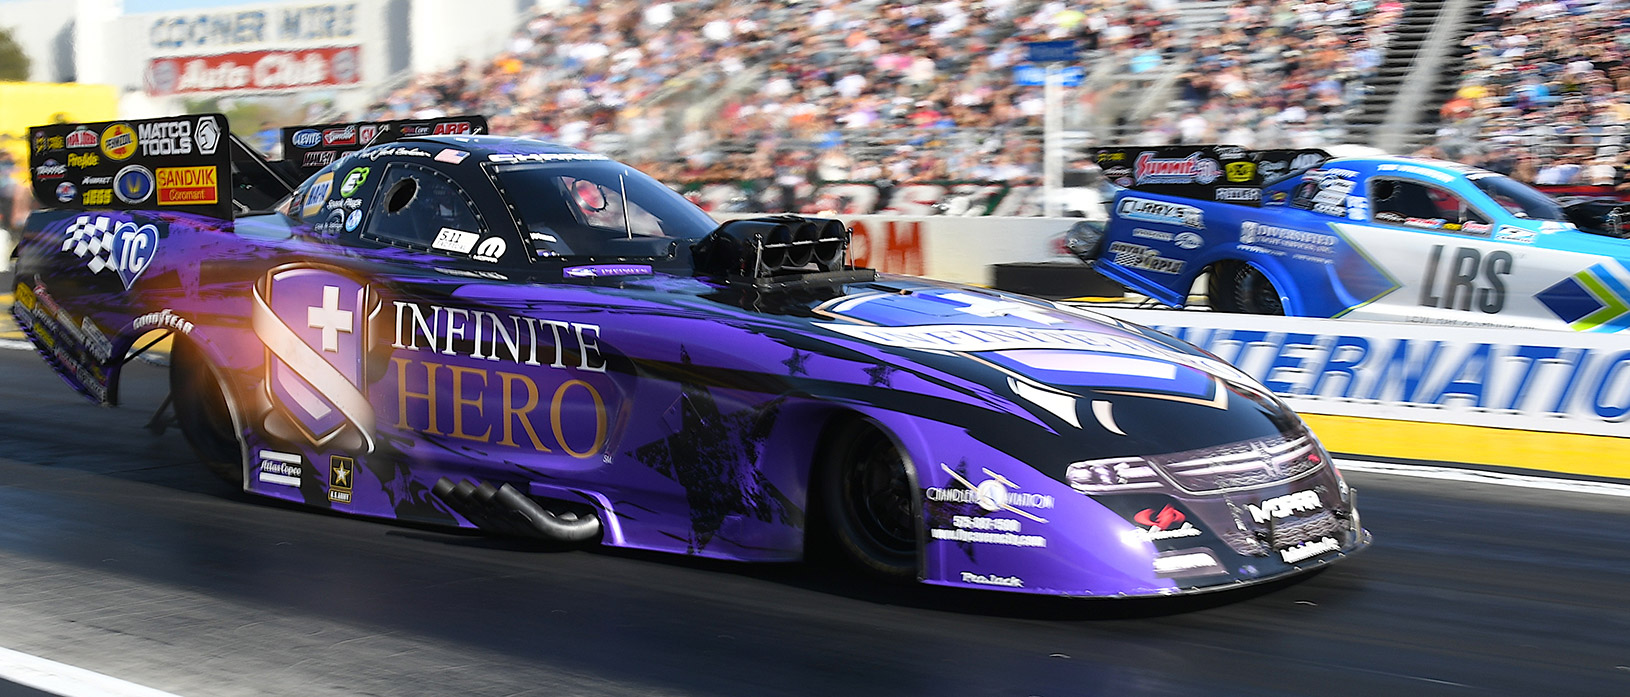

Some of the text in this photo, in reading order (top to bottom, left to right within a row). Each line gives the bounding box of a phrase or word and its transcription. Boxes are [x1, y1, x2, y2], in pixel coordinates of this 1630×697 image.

[177, 52, 329, 91] Auto Club
[138, 120, 191, 143] MATCO
[433, 123, 470, 135] ARP
[140, 137, 192, 157] TOOLS
[158, 168, 214, 187] SANDVIK
[82, 188, 113, 206] JEGS
[168, 188, 206, 201] Coromant
[440, 231, 461, 243] 5.11
[121, 231, 148, 274] TC
[1418, 245, 1513, 314] LRS
[133, 308, 194, 335] GOODYEAR
[391, 301, 607, 374] INFINITE
[391, 357, 608, 459] HERO
[261, 460, 281, 474] Atlas
